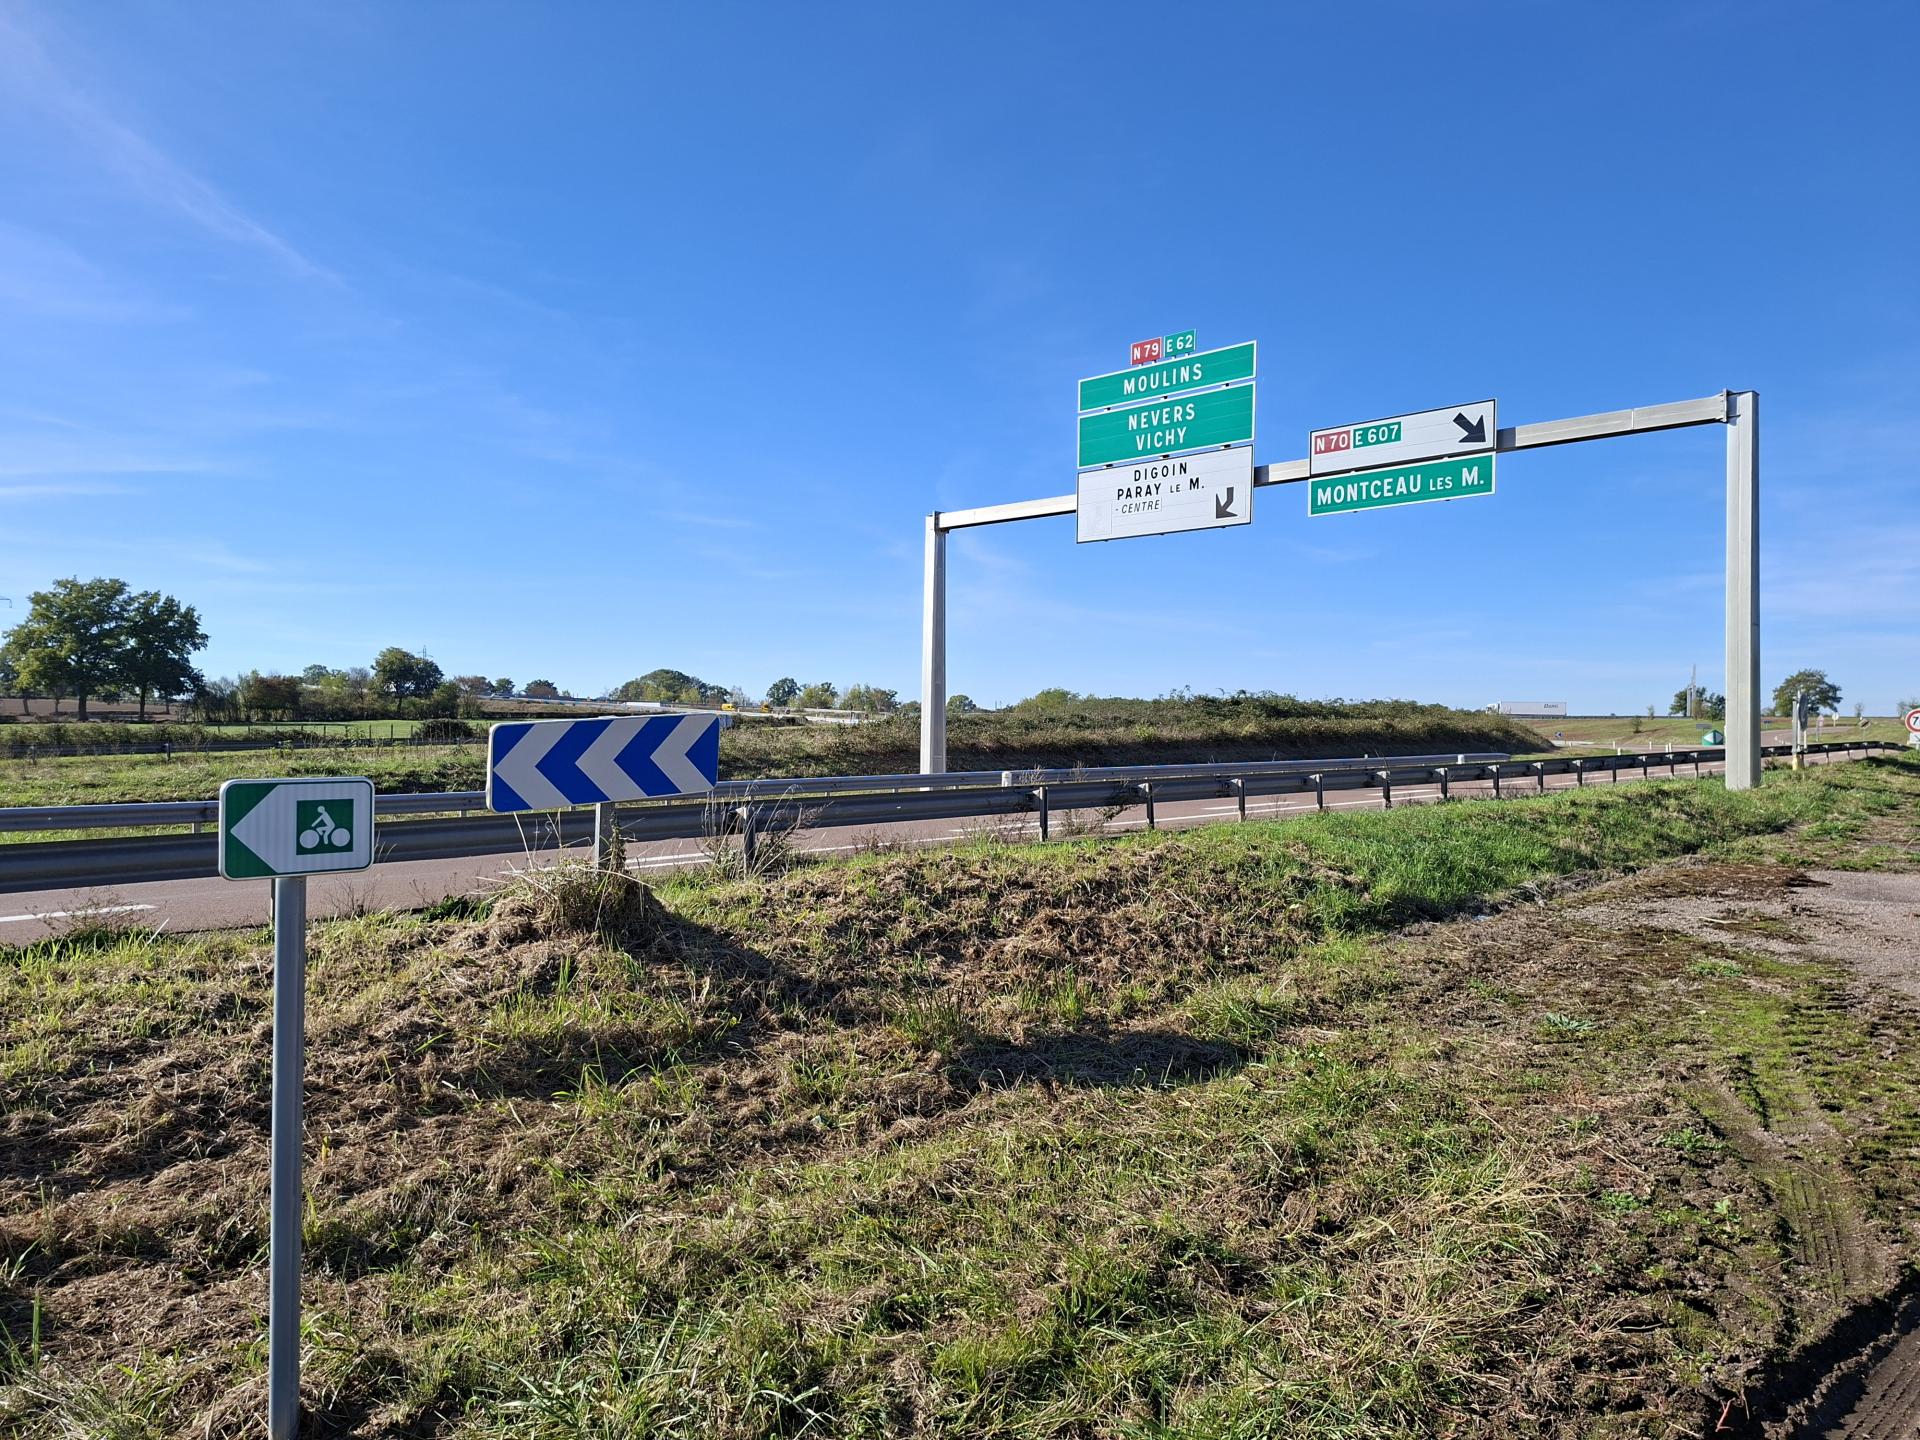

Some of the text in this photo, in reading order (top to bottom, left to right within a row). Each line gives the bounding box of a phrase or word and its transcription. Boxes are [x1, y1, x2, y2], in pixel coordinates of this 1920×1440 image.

[1133, 343, 1159, 360] N 79
[1166, 334, 1193, 353] E 62
[1123, 363, 1203, 395] MOULINS
[1128, 403, 1195, 430] NEVERS
[1135, 427, 1187, 451] VICHY
[1315, 433, 1348, 452] N 70
[1355, 424, 1399, 445] E 607
[1133, 462, 1188, 482] DIGOIN
[1117, 477, 1205, 501] PARAY LE M.
[1317, 466, 1484, 506] MONTCEAU LES M.
